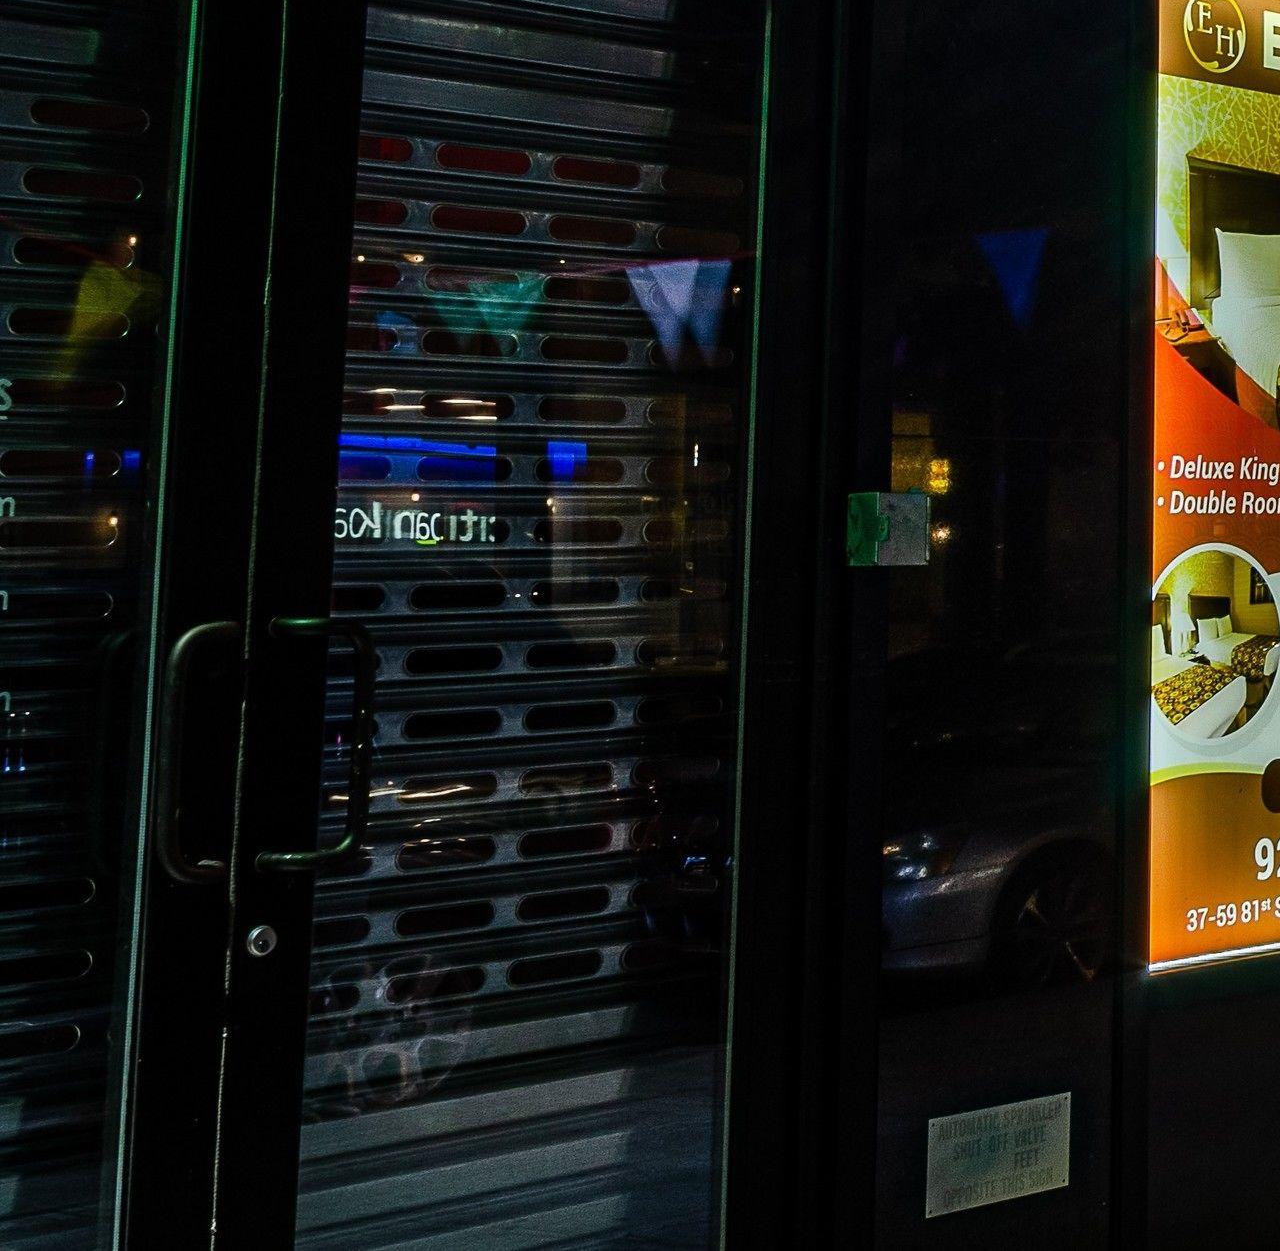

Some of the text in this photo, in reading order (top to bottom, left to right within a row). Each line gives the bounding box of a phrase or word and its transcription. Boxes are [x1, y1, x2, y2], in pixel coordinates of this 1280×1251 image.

[1170, 456, 1234, 481] Deluxe
[1240, 458, 1279, 485] King
[1170, 494, 1236, 516] Double
[1186, 905, 1237, 932] 37-59
[1241, 899, 1271, 924] 81st
